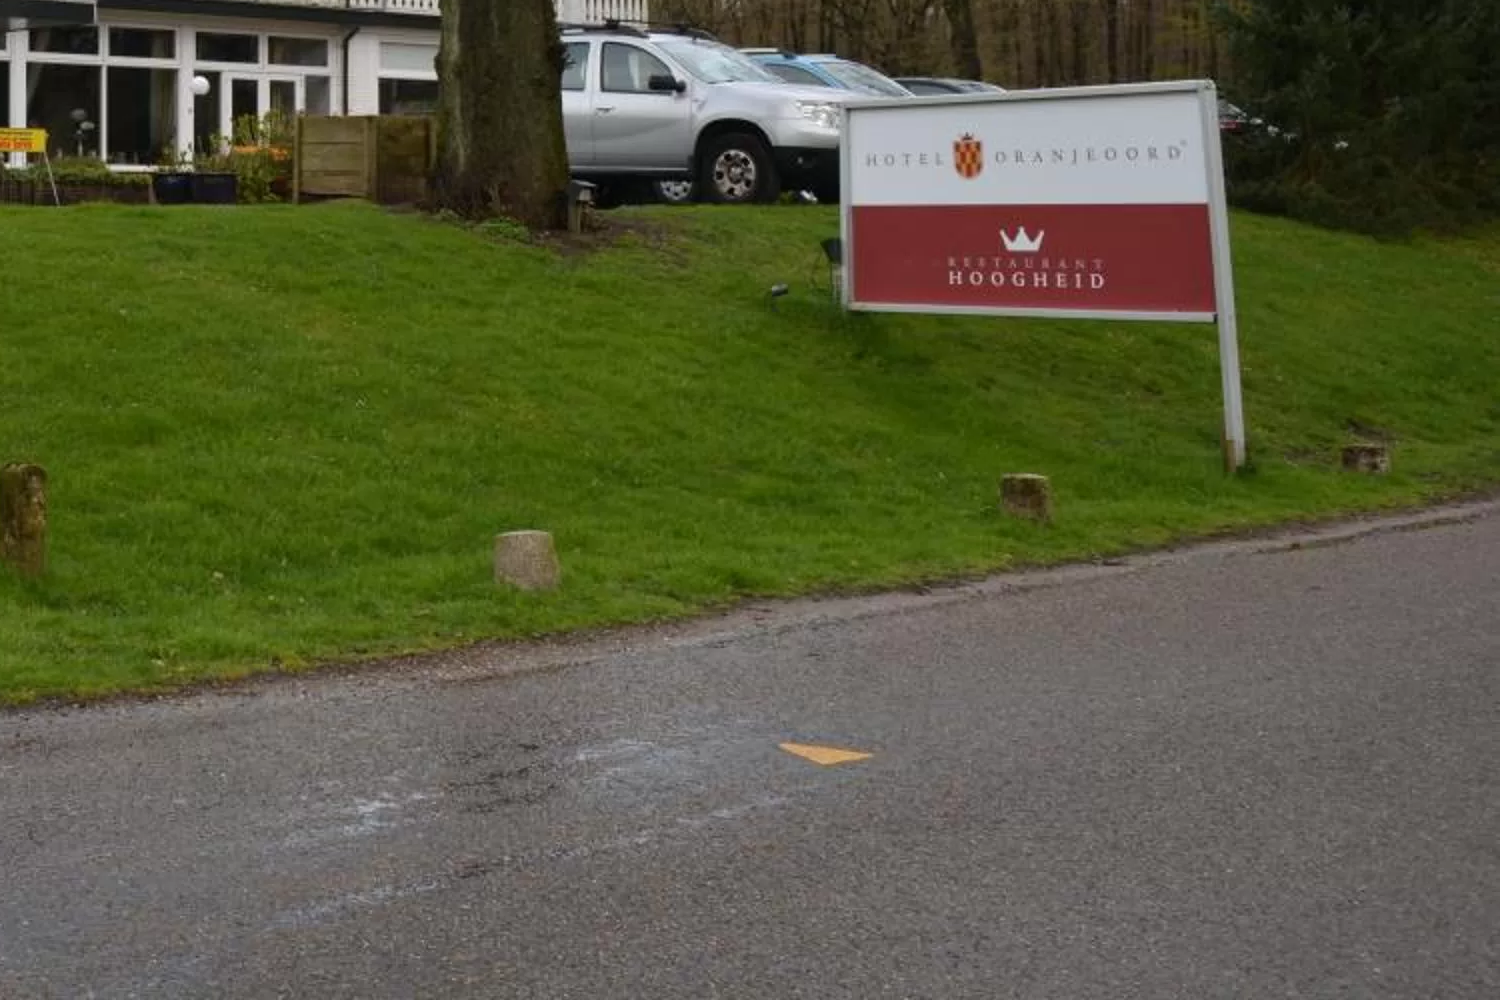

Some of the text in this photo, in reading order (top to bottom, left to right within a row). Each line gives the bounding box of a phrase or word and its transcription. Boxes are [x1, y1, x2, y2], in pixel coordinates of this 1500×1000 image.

[865, 150, 945, 168] HOTEL
[947, 256, 1105, 271] RESTAURANT
[948, 271, 1105, 290] HOOGHEID
